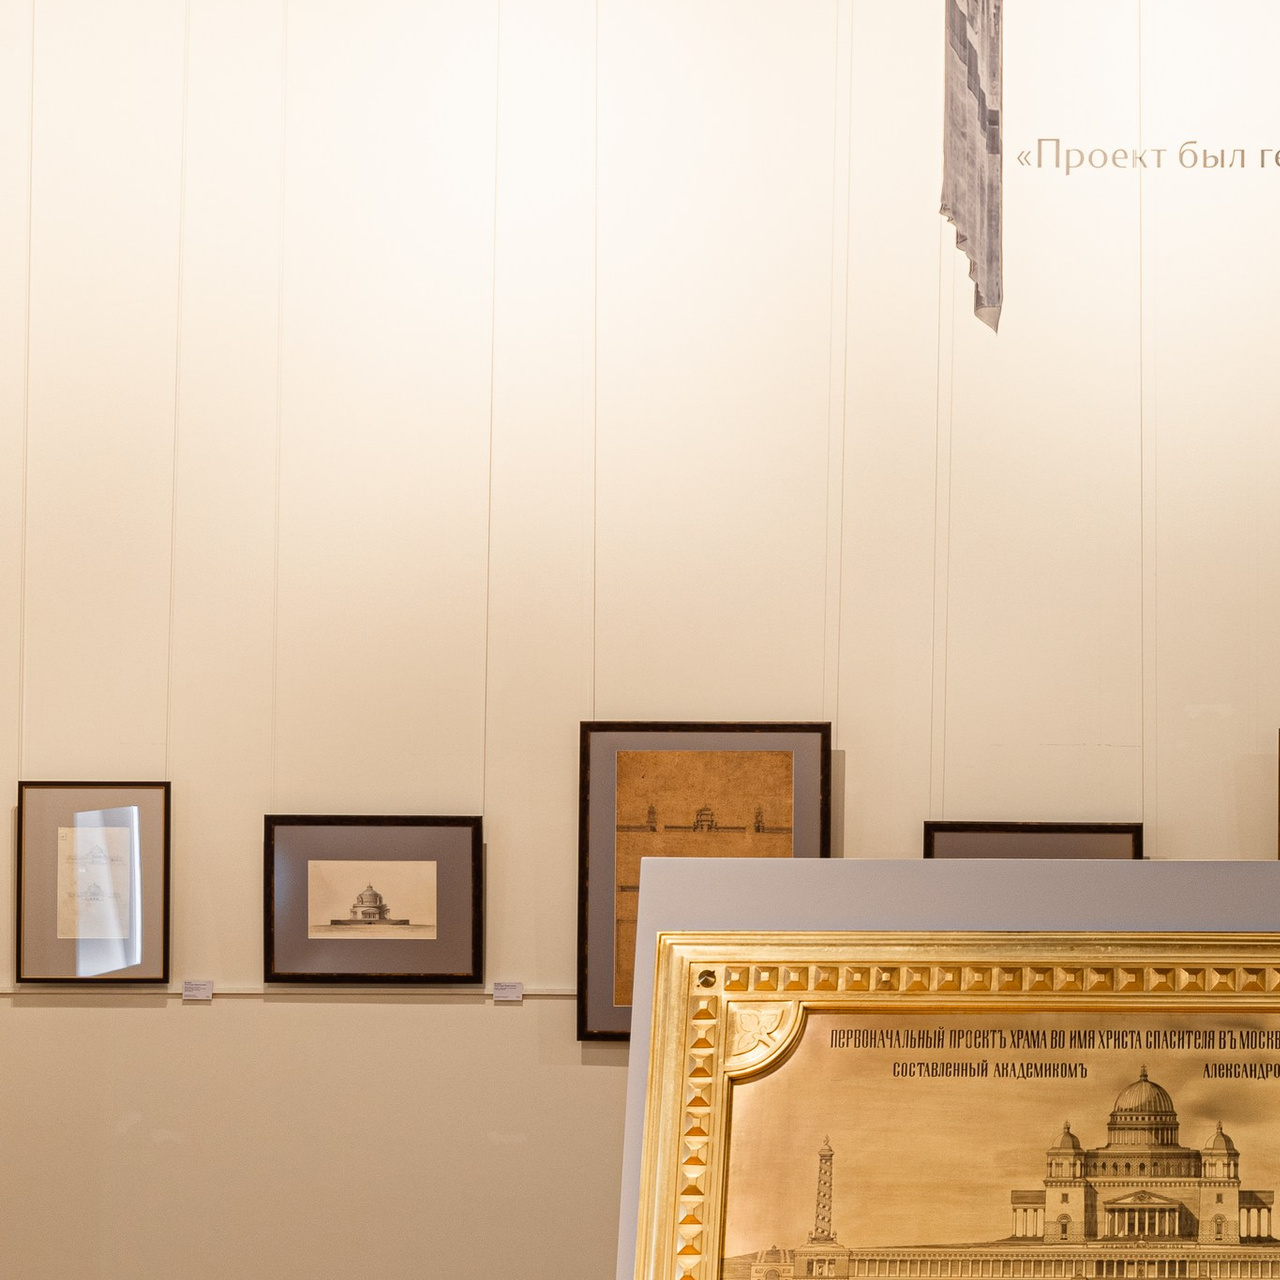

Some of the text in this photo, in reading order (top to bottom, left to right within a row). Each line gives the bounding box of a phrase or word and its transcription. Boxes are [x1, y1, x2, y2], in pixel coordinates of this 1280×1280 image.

[1016, 138, 1167, 176] «Проект
[1178, 140, 1246, 169] был
[830, 1026, 945, 1050] ПЕРВОНАЧАЛЬНЫЙ
[950, 1029, 1007, 1050] ПРОЕКТЪ
[1009, 1029, 1048, 1050] ХРАМА
[1050, 1029, 1066, 1050] ВО
[1069, 1029, 1096, 1050] ИМЯ
[1098, 1029, 1142, 1050] ХРИСТА
[1145, 1029, 1215, 1050] СПАСИТЕЛЯ
[1218, 1030, 1237, 1050] ВЪ
[893, 1060, 1088, 1080] СОСТАВЛЕННЫЙ АКАДЕМИКОМЪ
